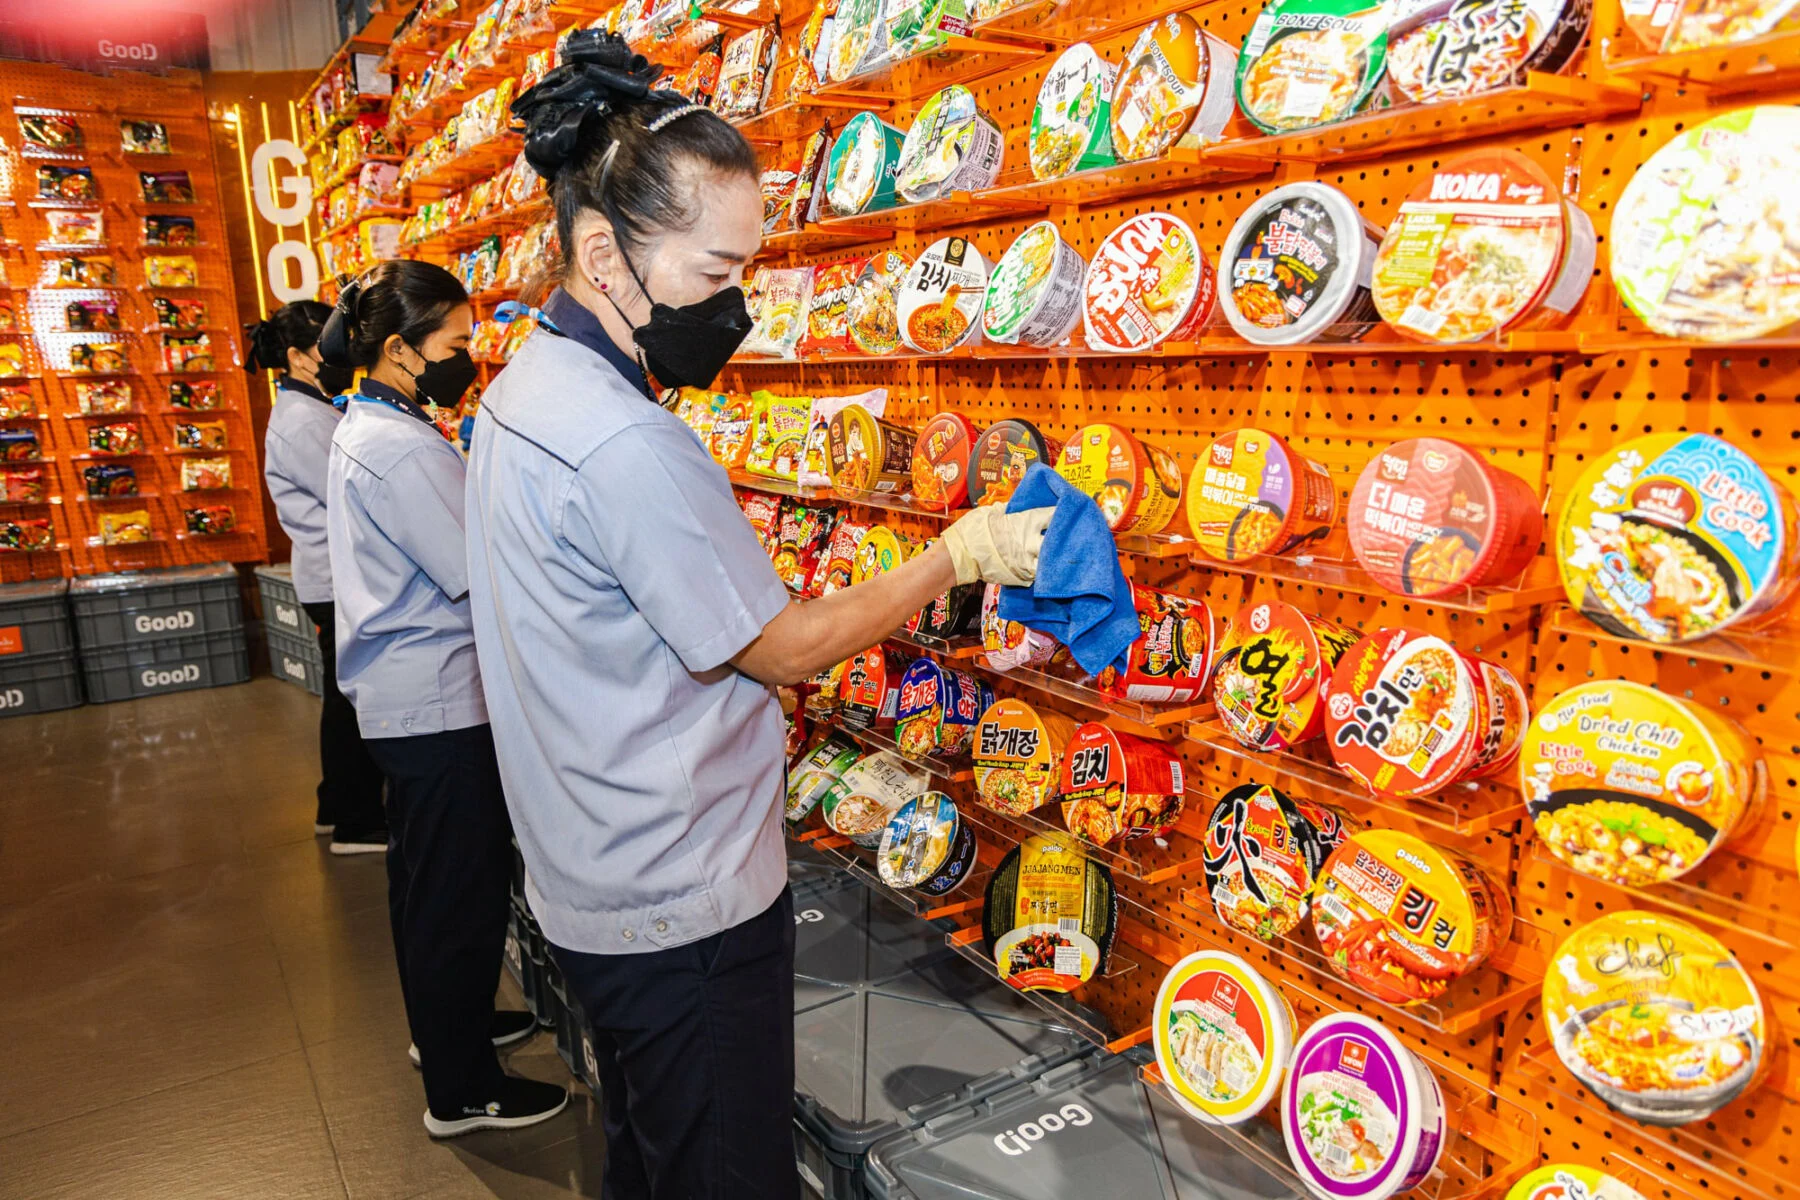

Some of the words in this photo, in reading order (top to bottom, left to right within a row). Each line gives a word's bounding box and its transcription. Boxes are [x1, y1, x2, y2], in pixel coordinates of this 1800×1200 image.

[1275, 15, 1320, 27] BONE
[1149, 40, 1167, 70] BONE
[1165, 66, 1186, 97] SOUP
[1430, 173, 1500, 201] KOKA
[916, 261, 952, 294] 김치
[1699, 469, 1768, 520] Little
[1706, 500, 1774, 551] Cook
[900, 674, 939, 713] 육개장
[981, 722, 1039, 758] 닭개장
[1580, 716, 1630, 735] Dried
[1634, 723, 1682, 747] Chili
[1597, 735, 1660, 758] Chicken
[1072, 744, 1109, 787] 김치
[1539, 742, 1584, 759] Little
[1554, 759, 1597, 779] Cook
[1042, 845, 1063, 853] paldo
[1396, 848, 1431, 874] paldo
[1355, 850, 1404, 892] 랍스타맛
[1402, 888, 1436, 930] 킹
[1433, 917, 1457, 949] 컵
[1595, 932, 1684, 978] Chef
